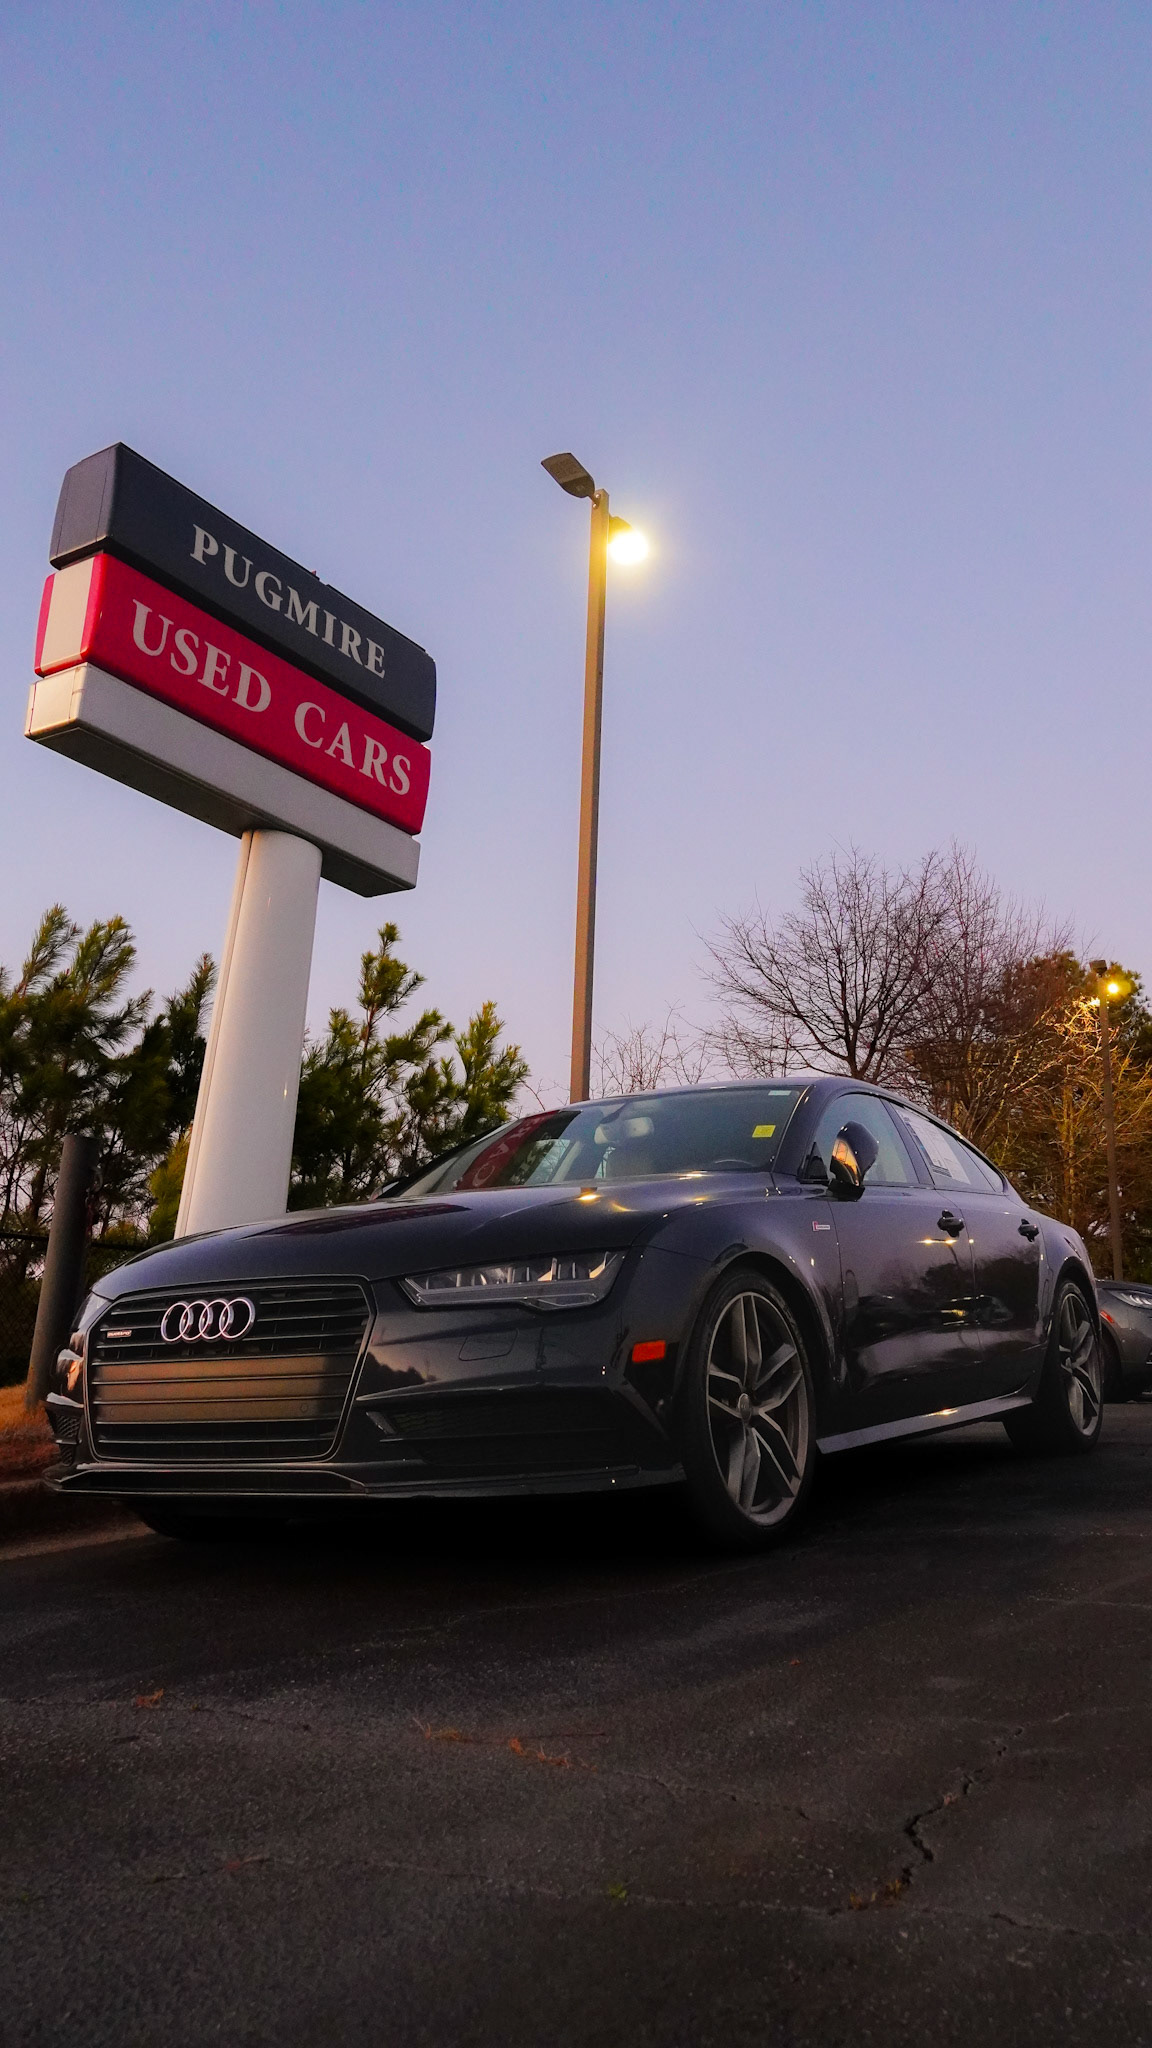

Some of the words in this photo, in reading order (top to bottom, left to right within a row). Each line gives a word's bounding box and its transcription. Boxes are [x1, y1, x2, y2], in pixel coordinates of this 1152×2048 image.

[191, 524, 387, 679] PUGMIRE
[133, 600, 272, 712] USED
[294, 702, 412, 796] CARS
